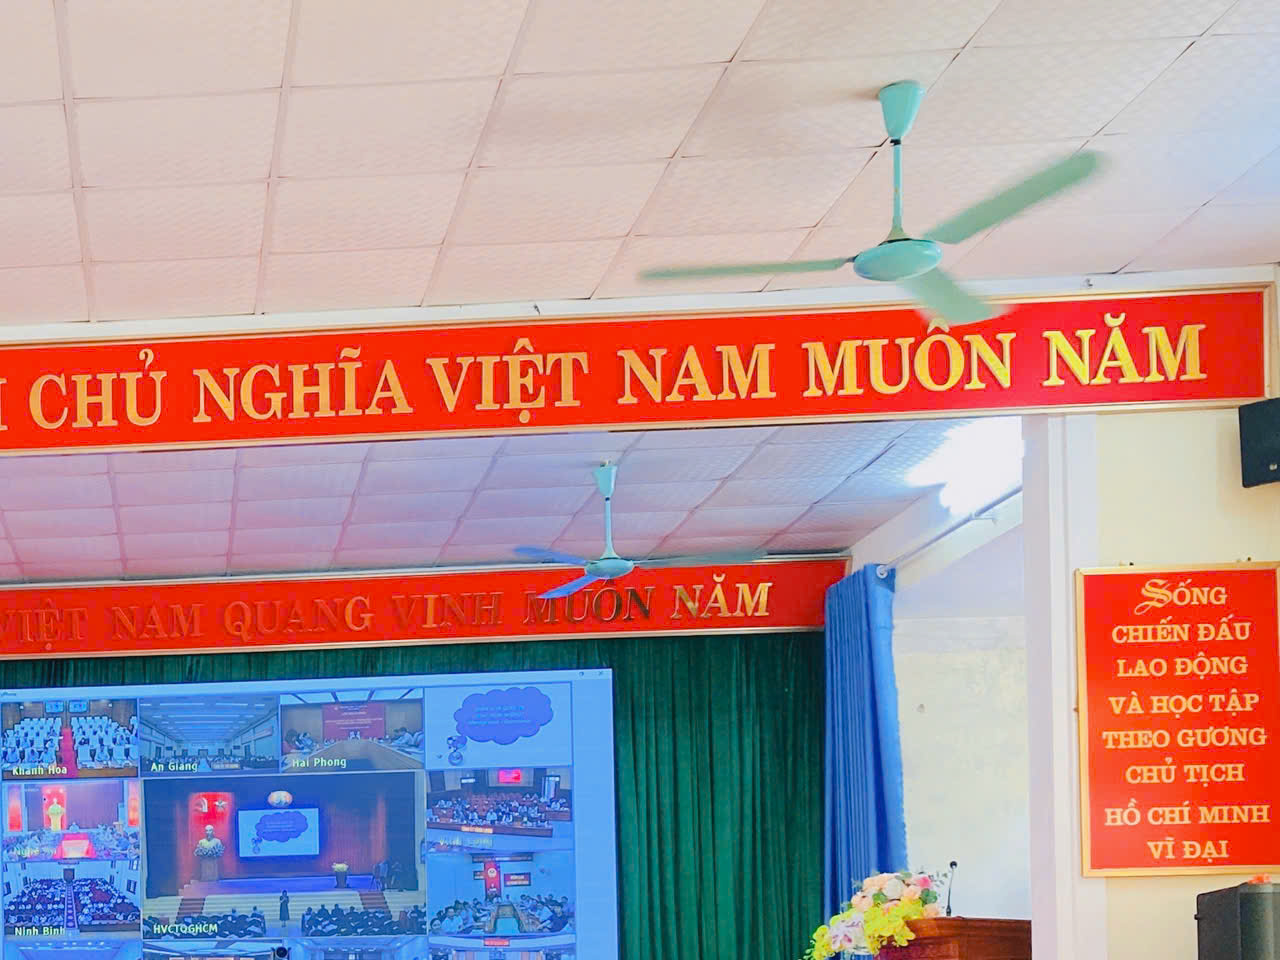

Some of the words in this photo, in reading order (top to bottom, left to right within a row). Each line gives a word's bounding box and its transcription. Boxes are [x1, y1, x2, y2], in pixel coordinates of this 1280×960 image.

[29, 348, 167, 430] CHỦ
[192, 347, 413, 422] NGHĨA
[426, 337, 589, 424] VIỆT
[617, 343, 776, 405] NAM
[802, 318, 1017, 398] MUÔN
[1042, 313, 1209, 389] NĂM
[110, 602, 205, 641] NAM
[223, 595, 375, 642] QUANG
[391, 590, 504, 631] VINH
[670, 573, 773, 620] NĂM
[1134, 578, 1228, 615] SỐNG
[1111, 616, 1191, 643] CHIẾN
[1197, 614, 1252, 642] ĐẤU
[1117, 658, 1168, 678] LAO
[1175, 652, 1249, 680] ĐỘNG
[1109, 691, 1145, 715] VÀ
[1150, 695, 1203, 718] HỌC
[1209, 688, 1260, 717] TẬP
[1102, 730, 1170, 749] THEO
[1177, 726, 1268, 748] GƯƠNG
[48, 766, 67, 775] Hoa
[151, 762, 164, 772] An
[168, 761, 198, 773] Giang
[292, 758, 309, 768] Hai
[314, 757, 347, 769] Phong
[1125, 757, 1177, 784] CHỦ
[1184, 763, 1245, 787] TỊCH
[1104, 798, 1141, 826] HỒ
[1147, 801, 1192, 825] CHÍ
[1199, 804, 1271, 825] MINH
[1147, 837, 1176, 859] VĨ
[1183, 840, 1230, 863] ĐẠI
[14, 927, 39, 936] Ninh
[43, 926, 65, 936] Binh
